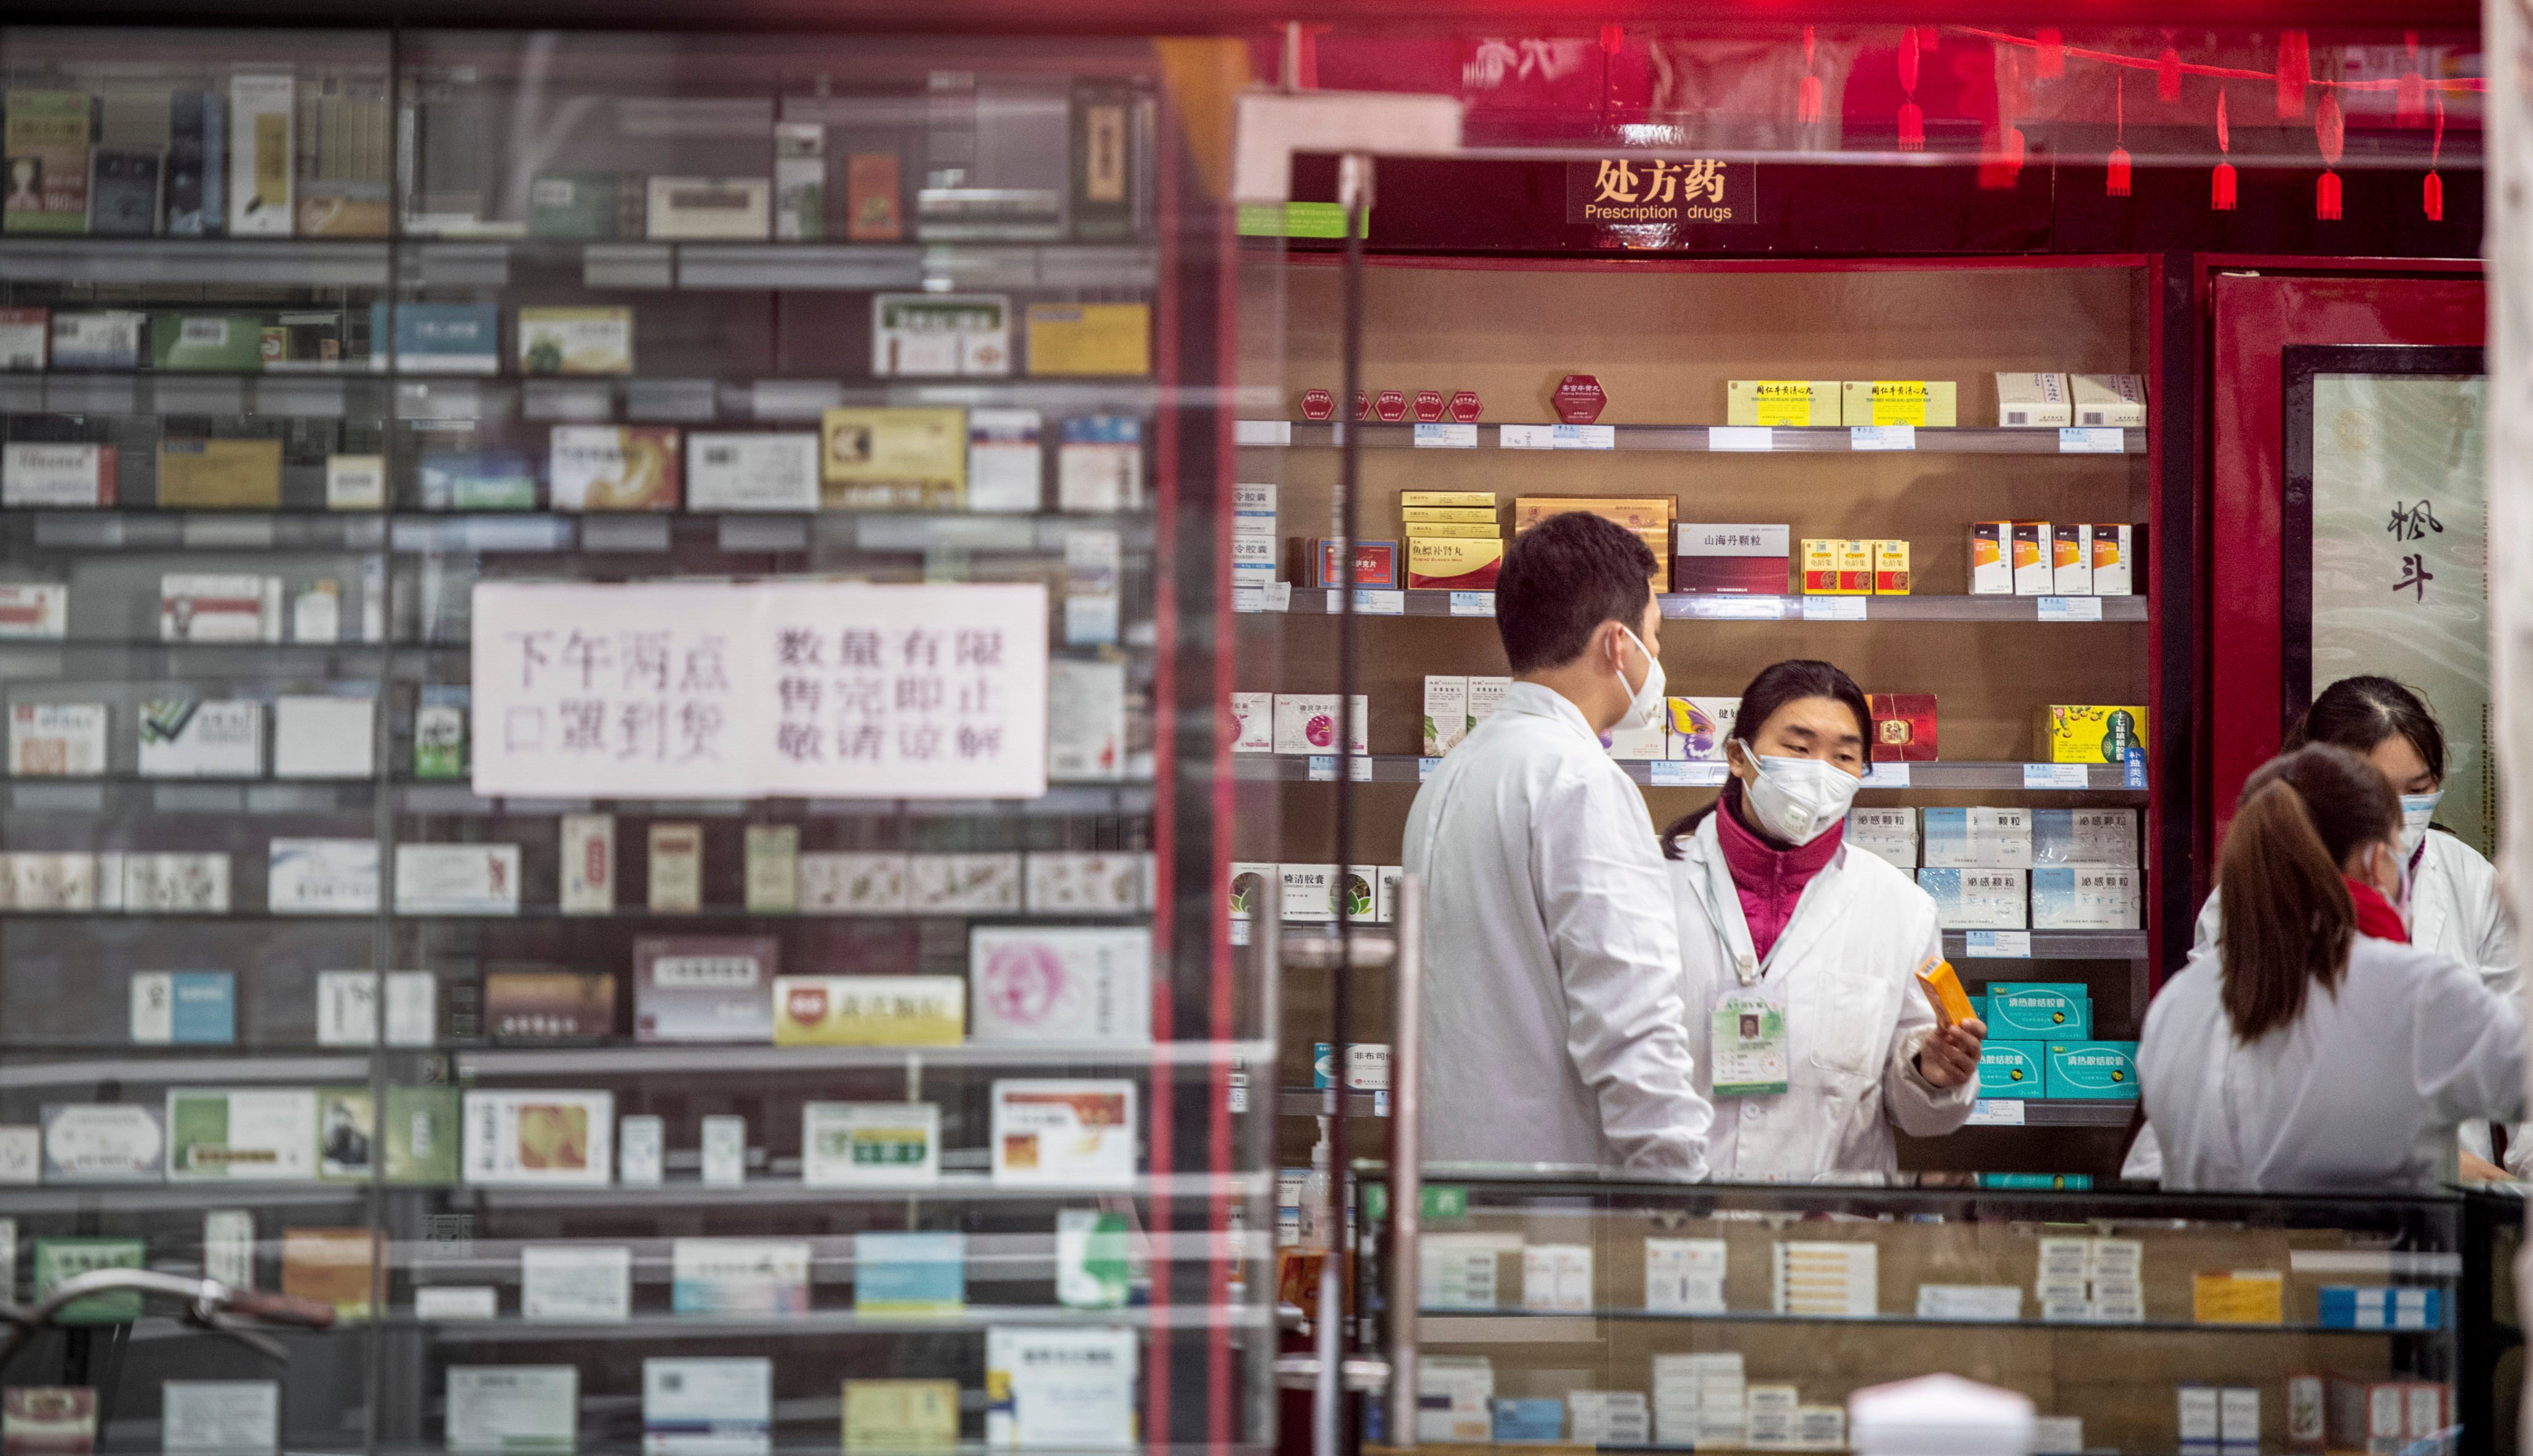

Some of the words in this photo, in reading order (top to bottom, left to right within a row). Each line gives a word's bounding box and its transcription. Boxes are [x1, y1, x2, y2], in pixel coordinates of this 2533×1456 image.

[1594, 158, 1727, 203] 处方药
[1585, 204, 1678, 221] Prescription
[1687, 205, 1732, 222] drugs
[1756, 384, 1814, 396] 同仁牛黄清心丸
[1871, 385, 1929, 396] 同仁牛黄清心丸
[1233, 492, 1267, 502] 令胶囊
[1232, 544, 1267, 554] 令胶囊
[1704, 534, 1762, 547] 山海丹颗粒
[2387, 499, 2445, 605] 枫斗
[776, 626, 1006, 670] 数量有限
[501, 630, 731, 692] 下午两点
[774, 675, 1003, 717] 售完即止
[504, 700, 727, 761] 口罩到货
[774, 721, 1003, 763] 敬请谅解
[2128, 750, 2143, 787] 补益类药
[2008, 997, 2065, 1008] 清热散结胶囊
[1979, 1055, 2023, 1066] 热散结胶囊
[2067, 1055, 2124, 1066] 清热散结胶囊
